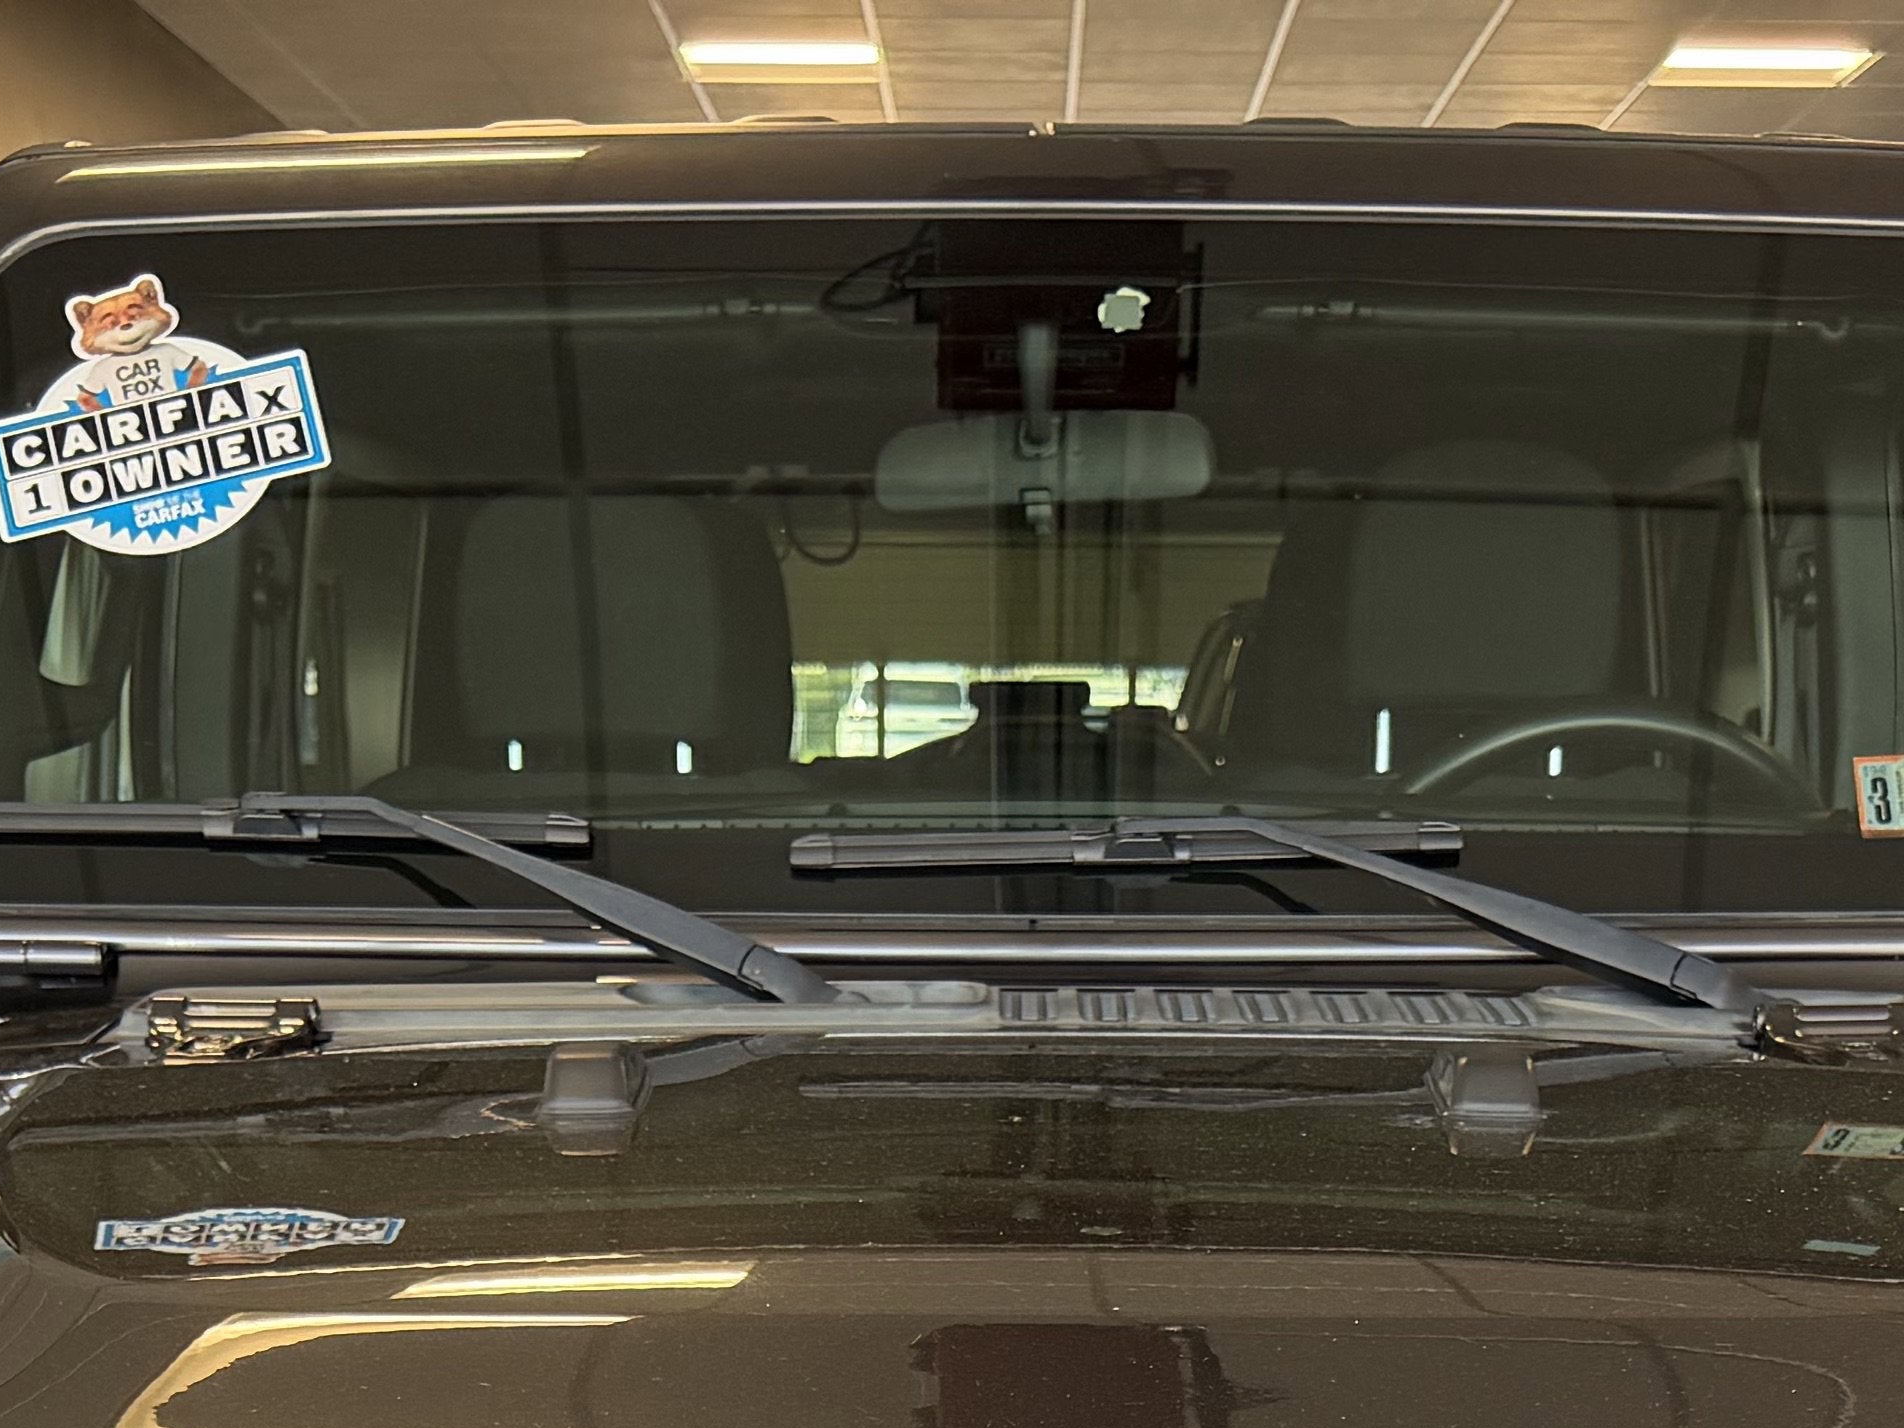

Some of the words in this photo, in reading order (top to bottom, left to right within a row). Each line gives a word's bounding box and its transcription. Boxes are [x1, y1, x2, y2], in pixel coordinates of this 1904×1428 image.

[115, 358, 161, 382] CAR
[122, 378, 165, 400] FOX
[10, 384, 293, 469] CARFAX
[23, 482, 52, 514] 1
[69, 424, 299, 505] OWNER
[134, 498, 207, 529] CARFAX
[1870, 777, 1892, 824] 3
